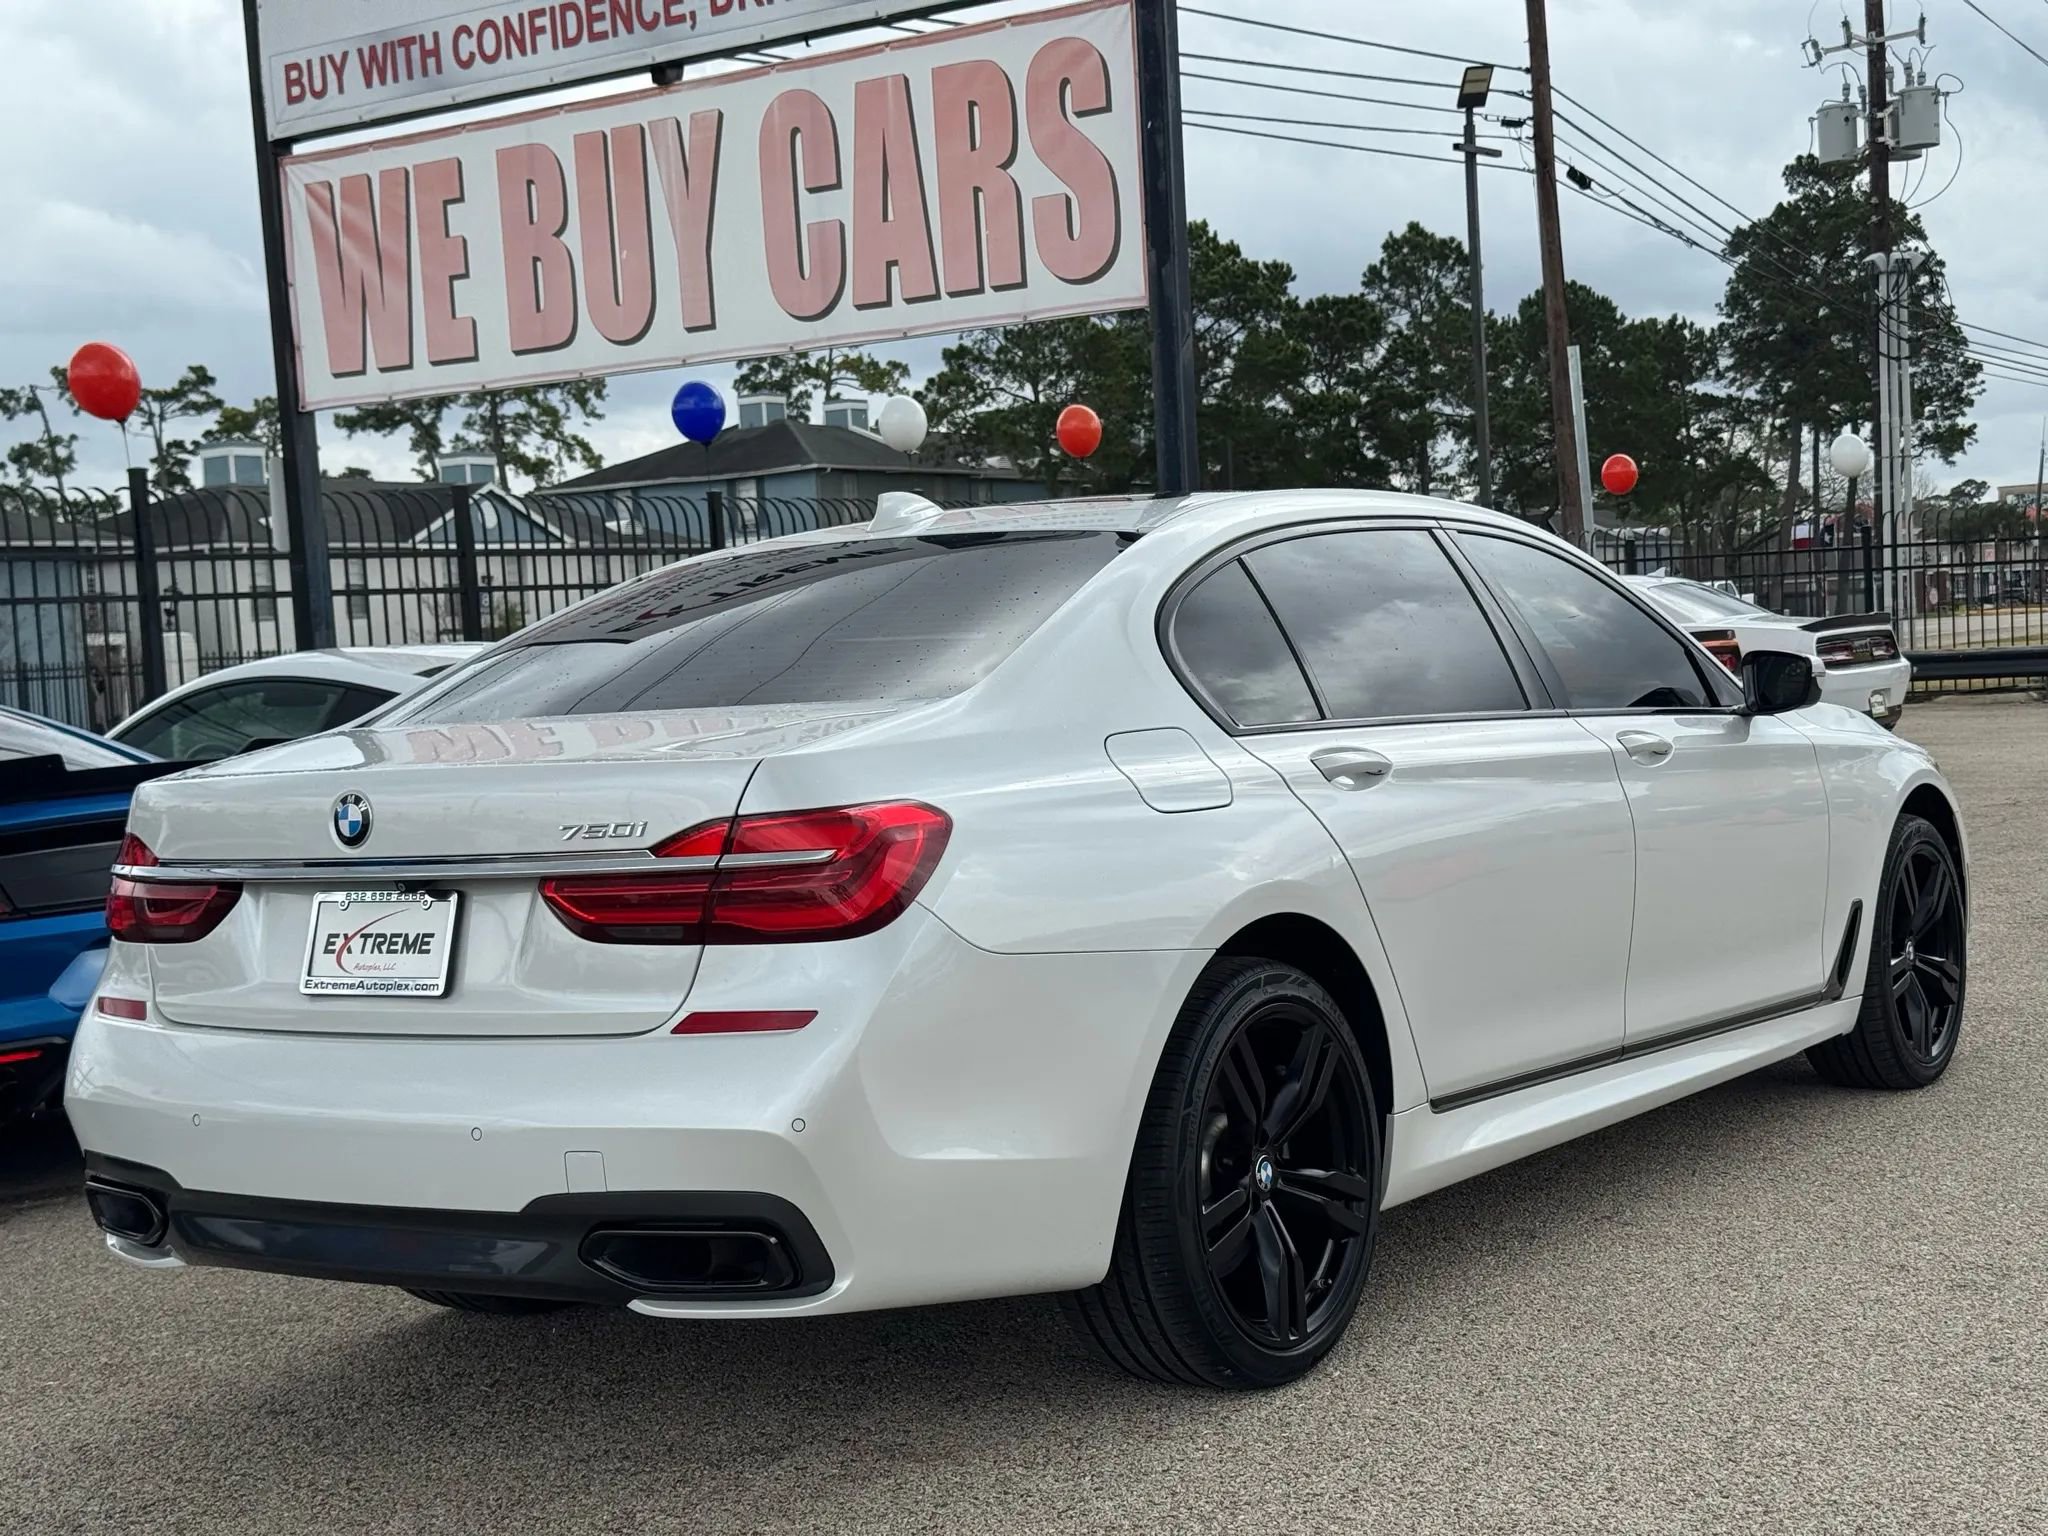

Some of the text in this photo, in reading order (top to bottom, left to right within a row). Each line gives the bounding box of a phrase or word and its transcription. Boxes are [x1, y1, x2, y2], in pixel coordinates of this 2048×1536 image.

[284, 0, 697, 106] BUY WITH CONFIDENCE,
[304, 36, 1122, 379] WE BUY CARS
[558, 820, 649, 842] 750i
[322, 933, 435, 955] EXTREME
[304, 979, 439, 993] ExtremeAutoplex.com
